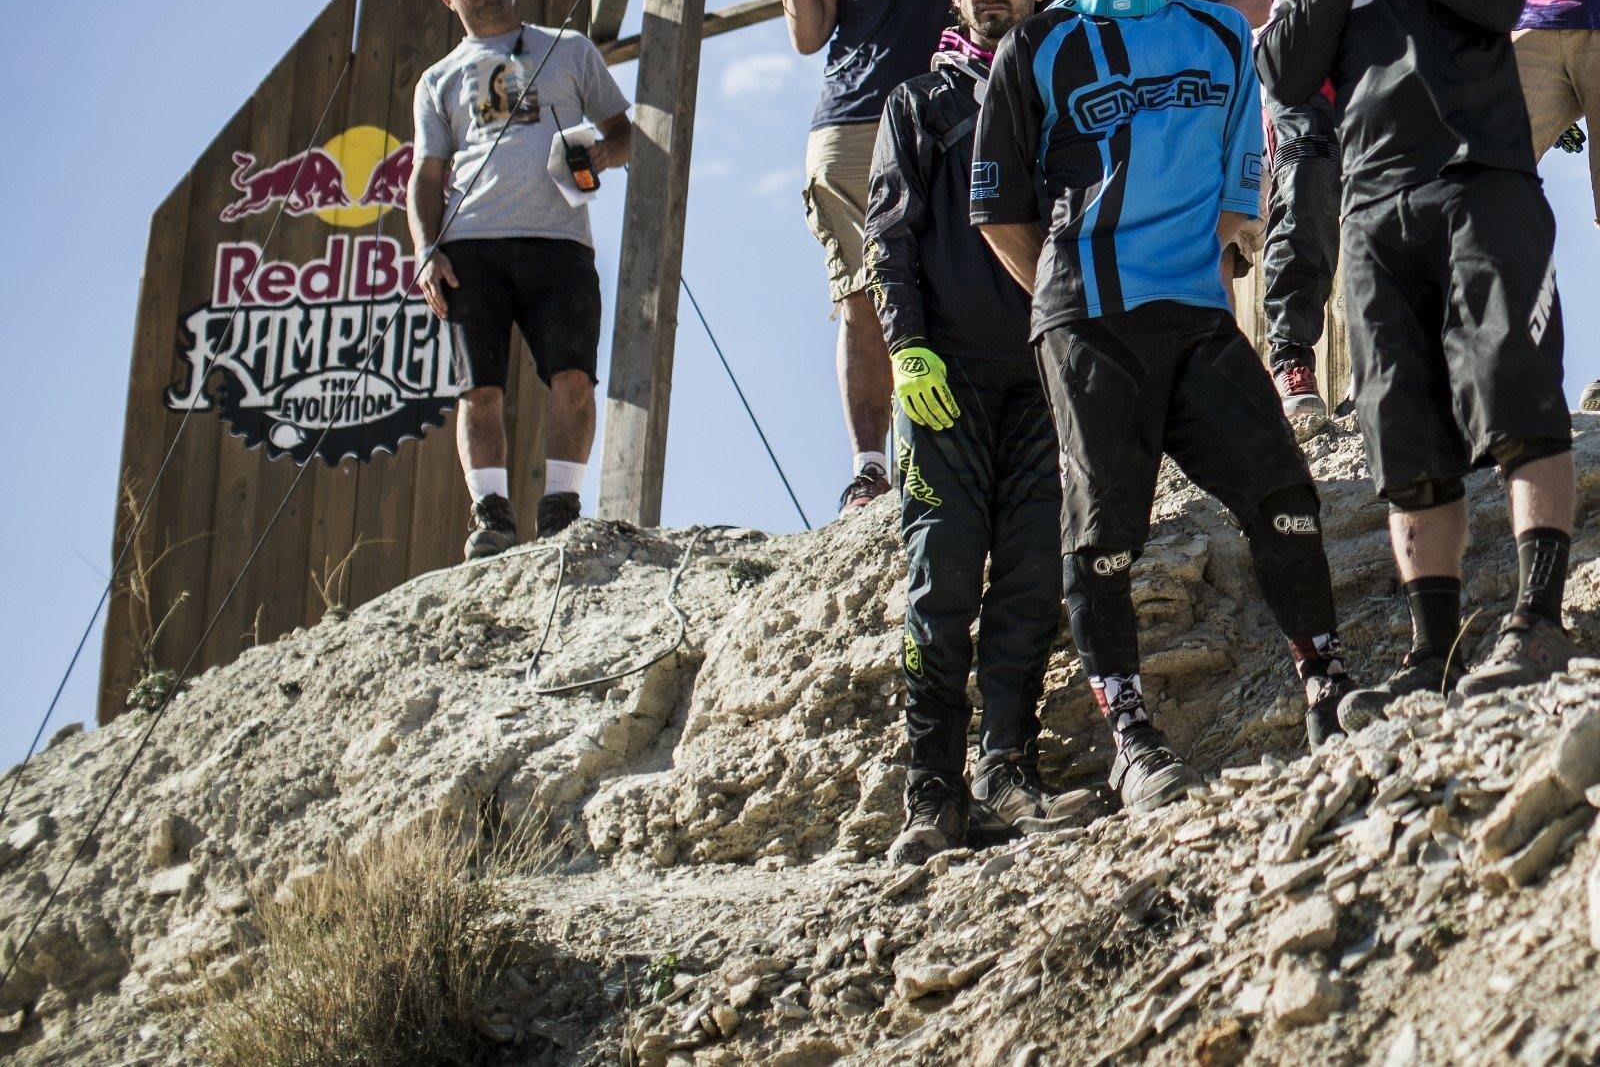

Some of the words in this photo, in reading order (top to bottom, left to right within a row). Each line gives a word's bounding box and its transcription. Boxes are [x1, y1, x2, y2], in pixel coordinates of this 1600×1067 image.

[1078, 71, 1230, 131] ONEAL
[213, 235, 349, 308] Red
[352, 235, 430, 301] Bu
[320, 378, 357, 392] THE
[278, 393, 394, 423] EVOLUTION
[1273, 514, 1319, 534] ONEAL
